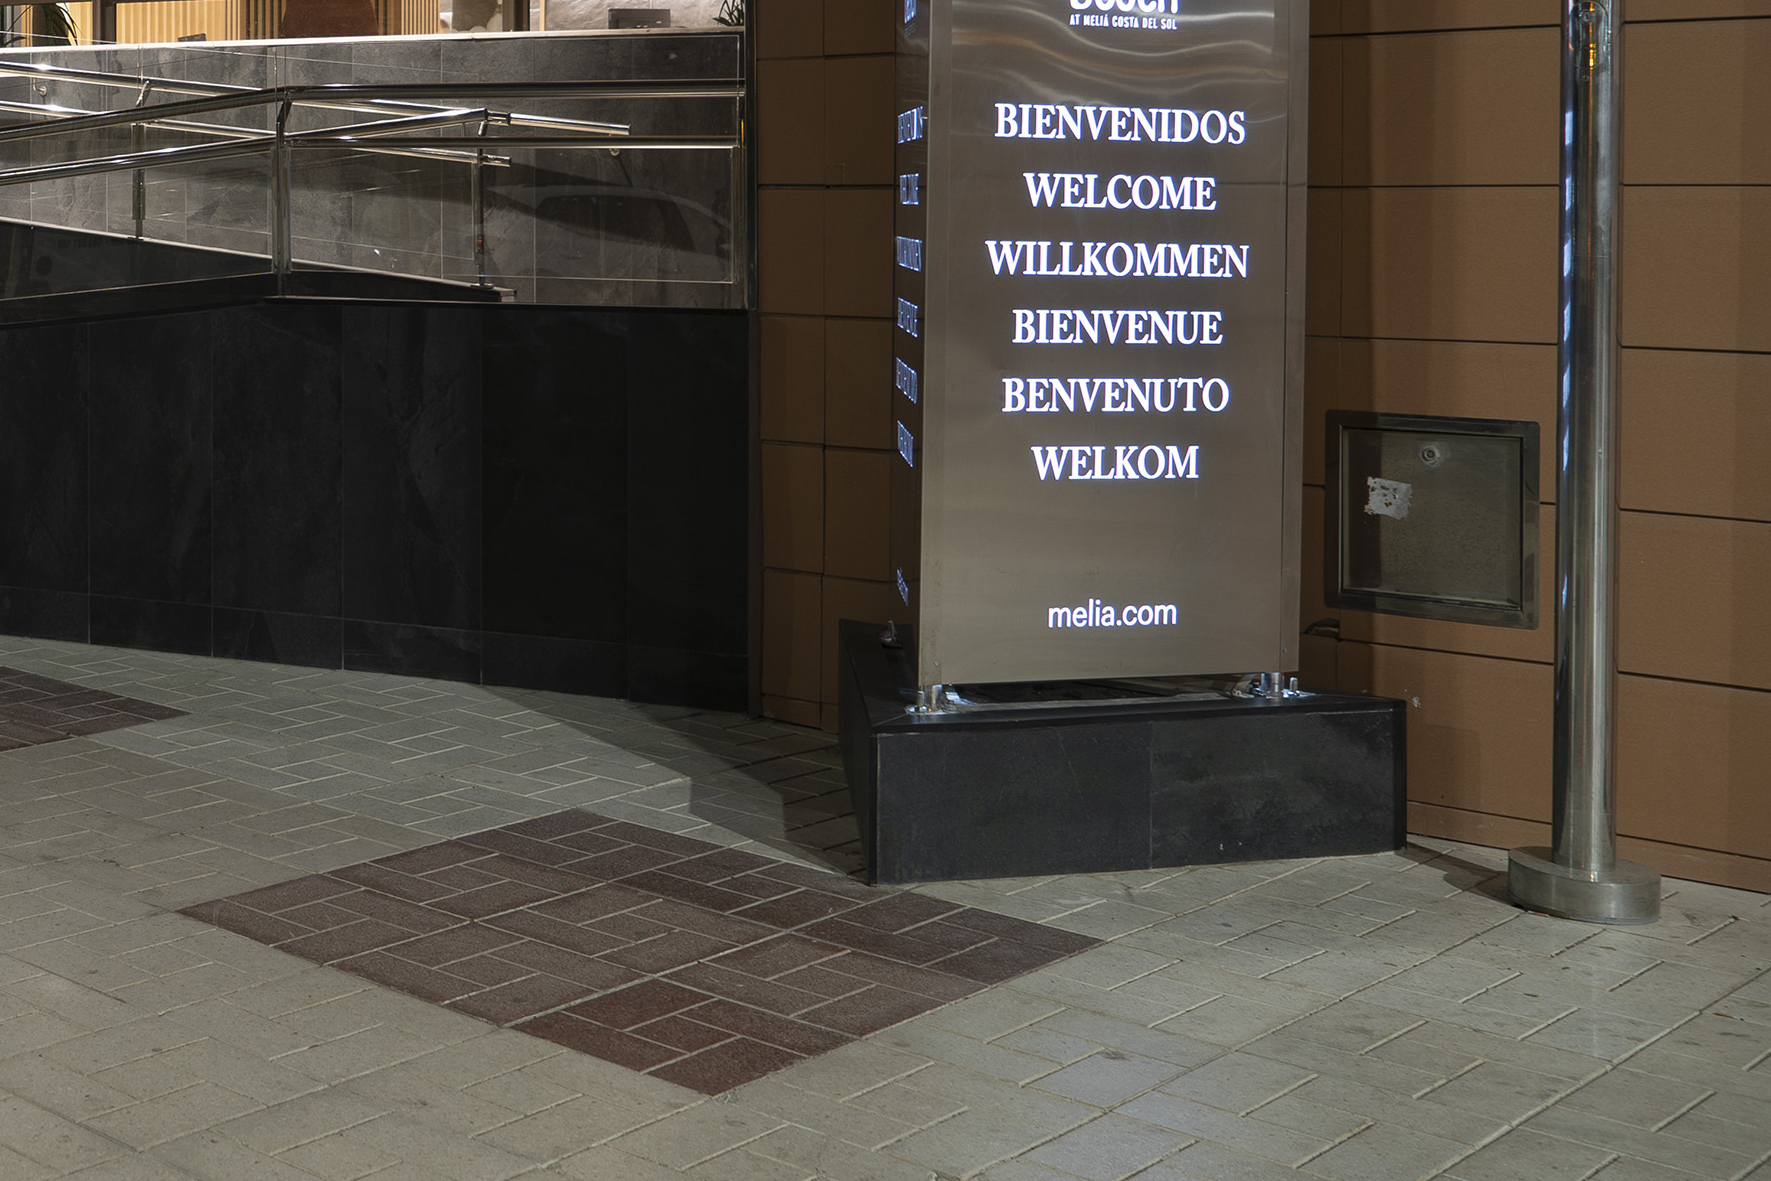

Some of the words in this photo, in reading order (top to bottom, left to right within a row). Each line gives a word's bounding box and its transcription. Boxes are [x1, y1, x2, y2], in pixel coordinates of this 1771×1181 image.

[1069, 13, 1081, 26] AT
[1111, 15, 1140, 29] COSTA
[1142, 17, 1158, 30] DEL
[1160, 18, 1179, 31] SOL
[993, 102, 1246, 145] BIENVENIDOS
[1022, 171, 1218, 211] WELCOME
[984, 239, 1250, 279] WILLKOMMEN
[1011, 308, 1224, 346] BIENVENUE
[1000, 376, 1230, 413] BENVENUTO
[1029, 444, 1200, 482] WELKOM
[1047, 597, 1178, 629] melia.com
